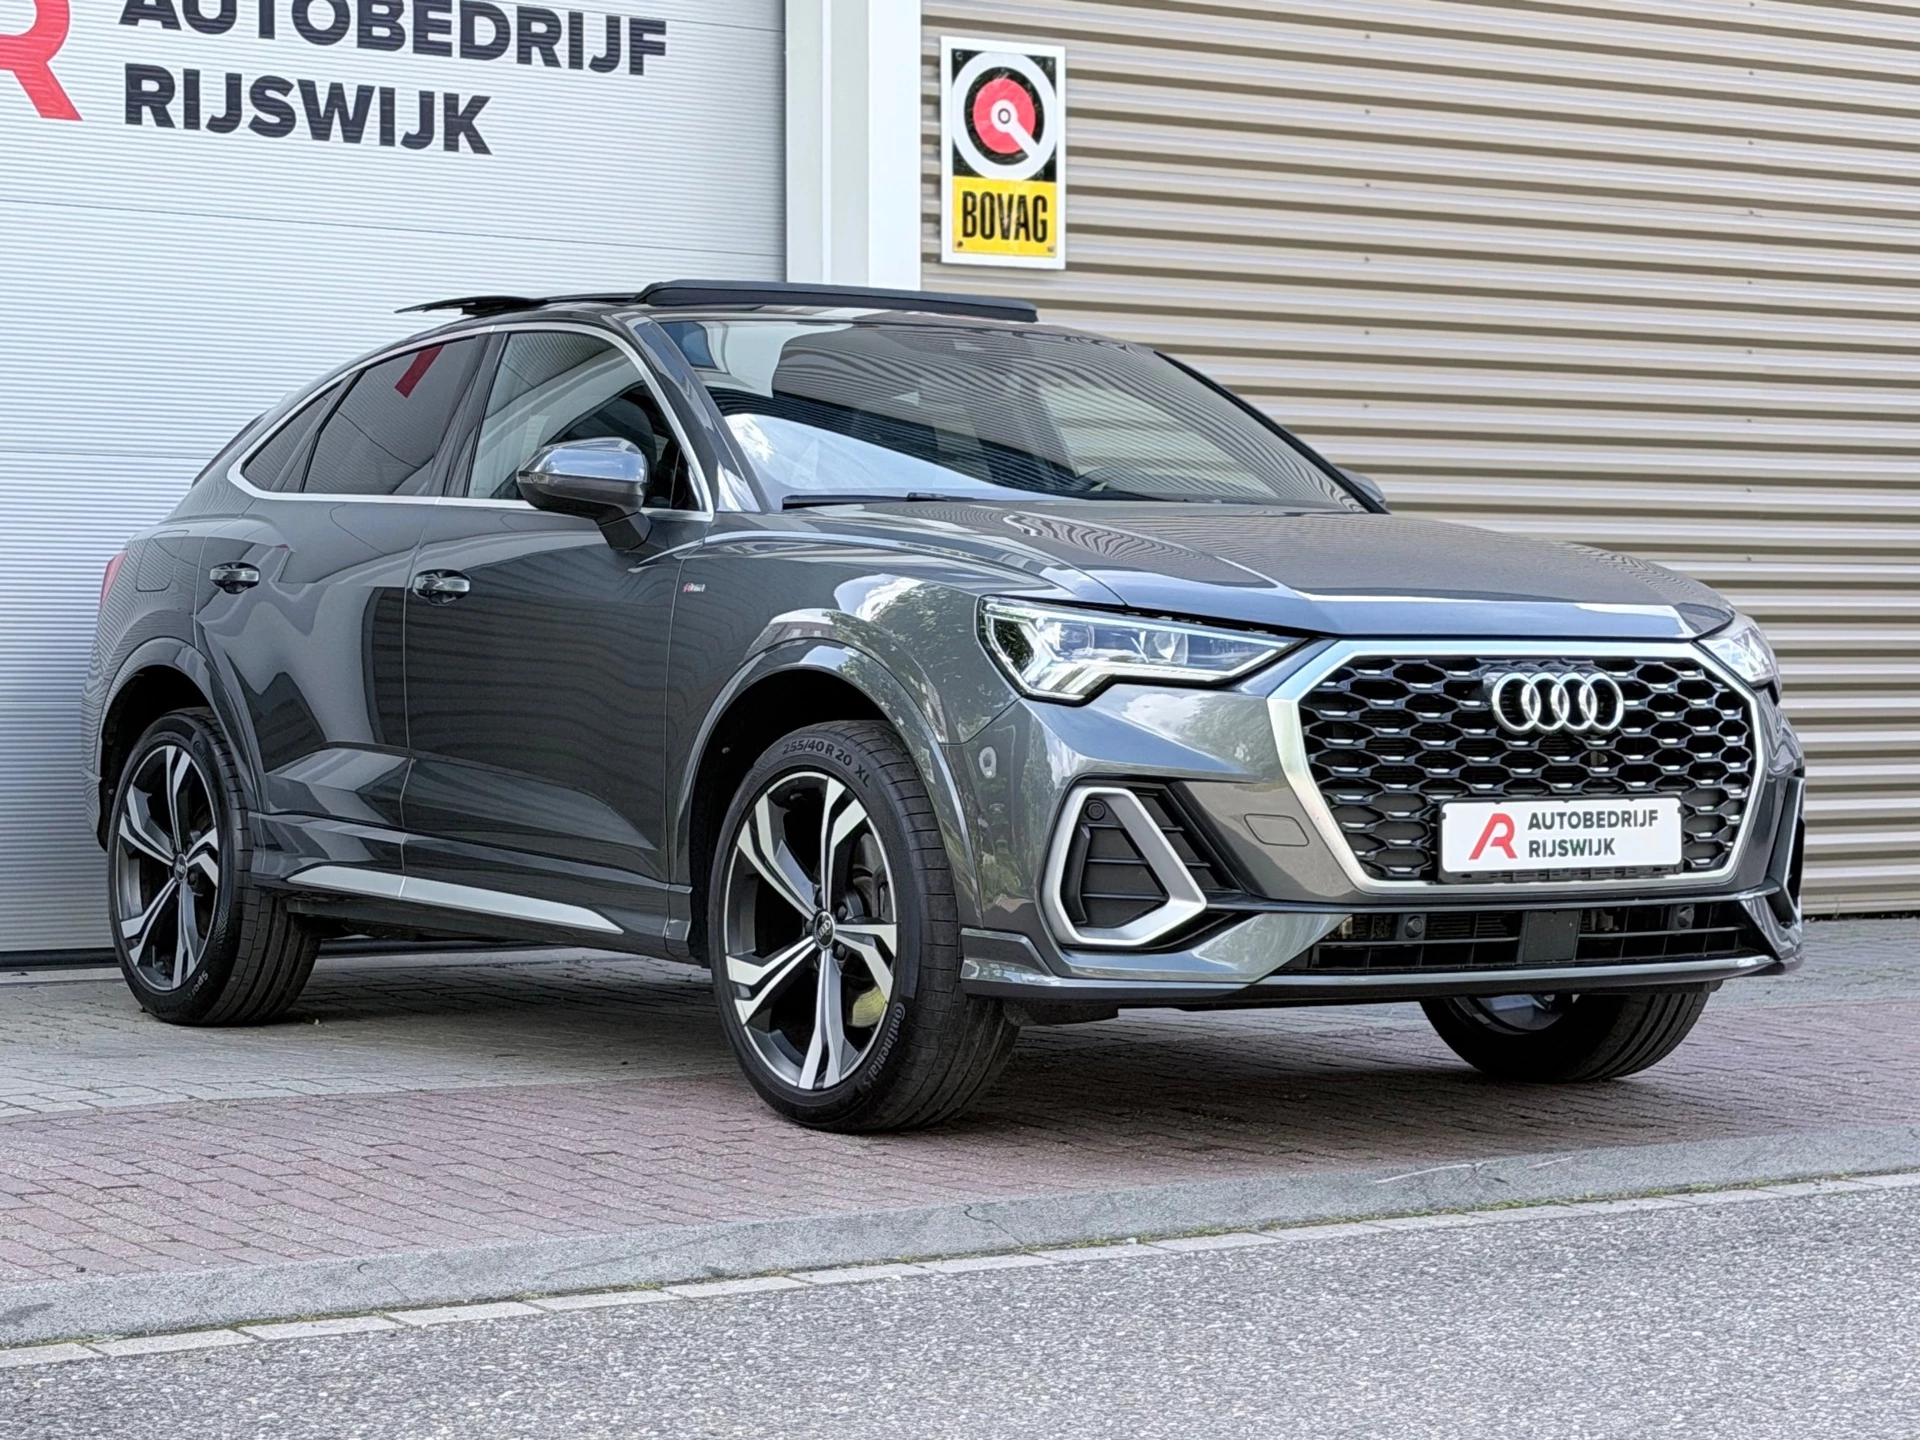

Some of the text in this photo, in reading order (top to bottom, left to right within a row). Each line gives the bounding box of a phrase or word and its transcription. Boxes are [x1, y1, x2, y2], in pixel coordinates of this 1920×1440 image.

[124, 62, 493, 156] RIJSWIJK
[961, 190, 1048, 243] BOVAG
[782, 739, 870, 788] 255/40 R 20 XL
[1527, 809, 1659, 831] AUTOBEDRIJF
[1528, 837, 1616, 859] RIJSWIJK
[867, 1002, 906, 1082] Continental
